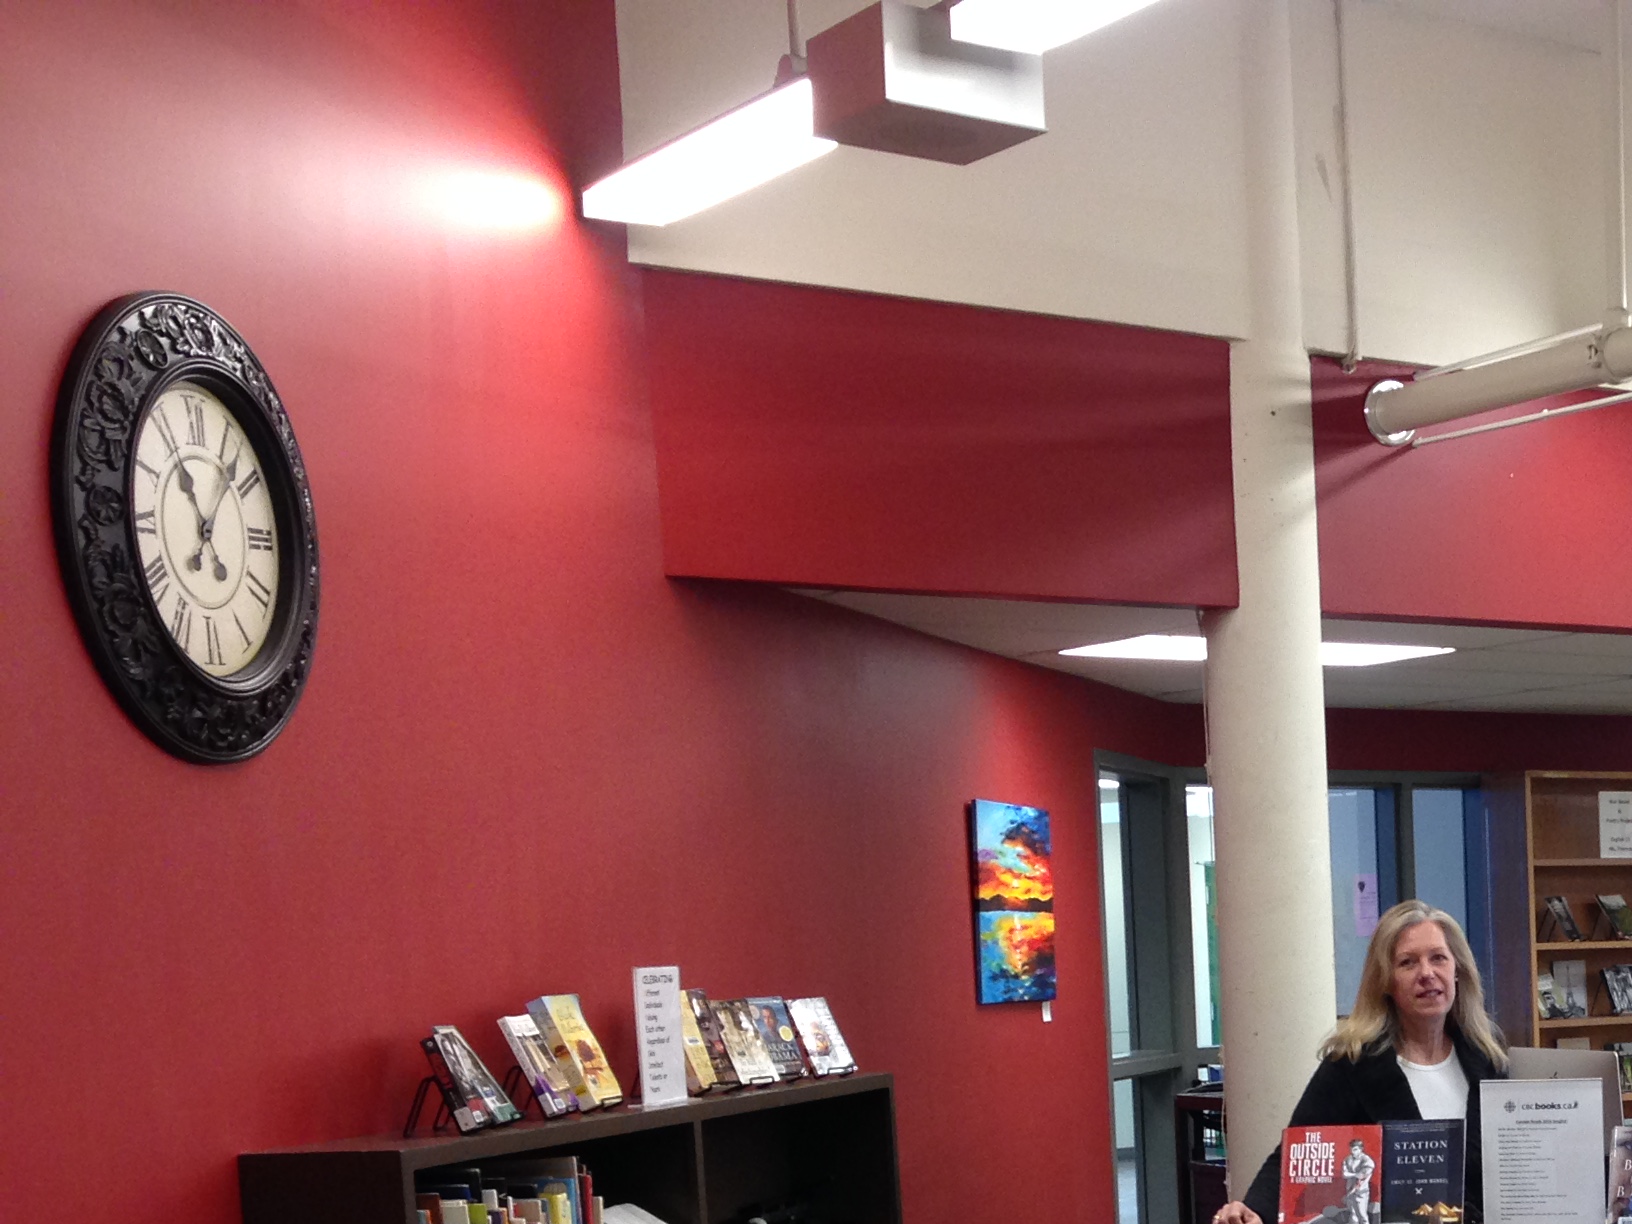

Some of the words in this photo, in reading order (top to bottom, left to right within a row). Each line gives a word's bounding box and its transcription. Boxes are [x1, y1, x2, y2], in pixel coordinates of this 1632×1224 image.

[1305, 1131, 1321, 1143] THE
[1290, 1142, 1335, 1160] OUTSIDE
[1394, 1140, 1448, 1150] STATION
[1397, 1155, 1445, 1164] ELEVEN
[1289, 1159, 1335, 1177] CIRCLE
